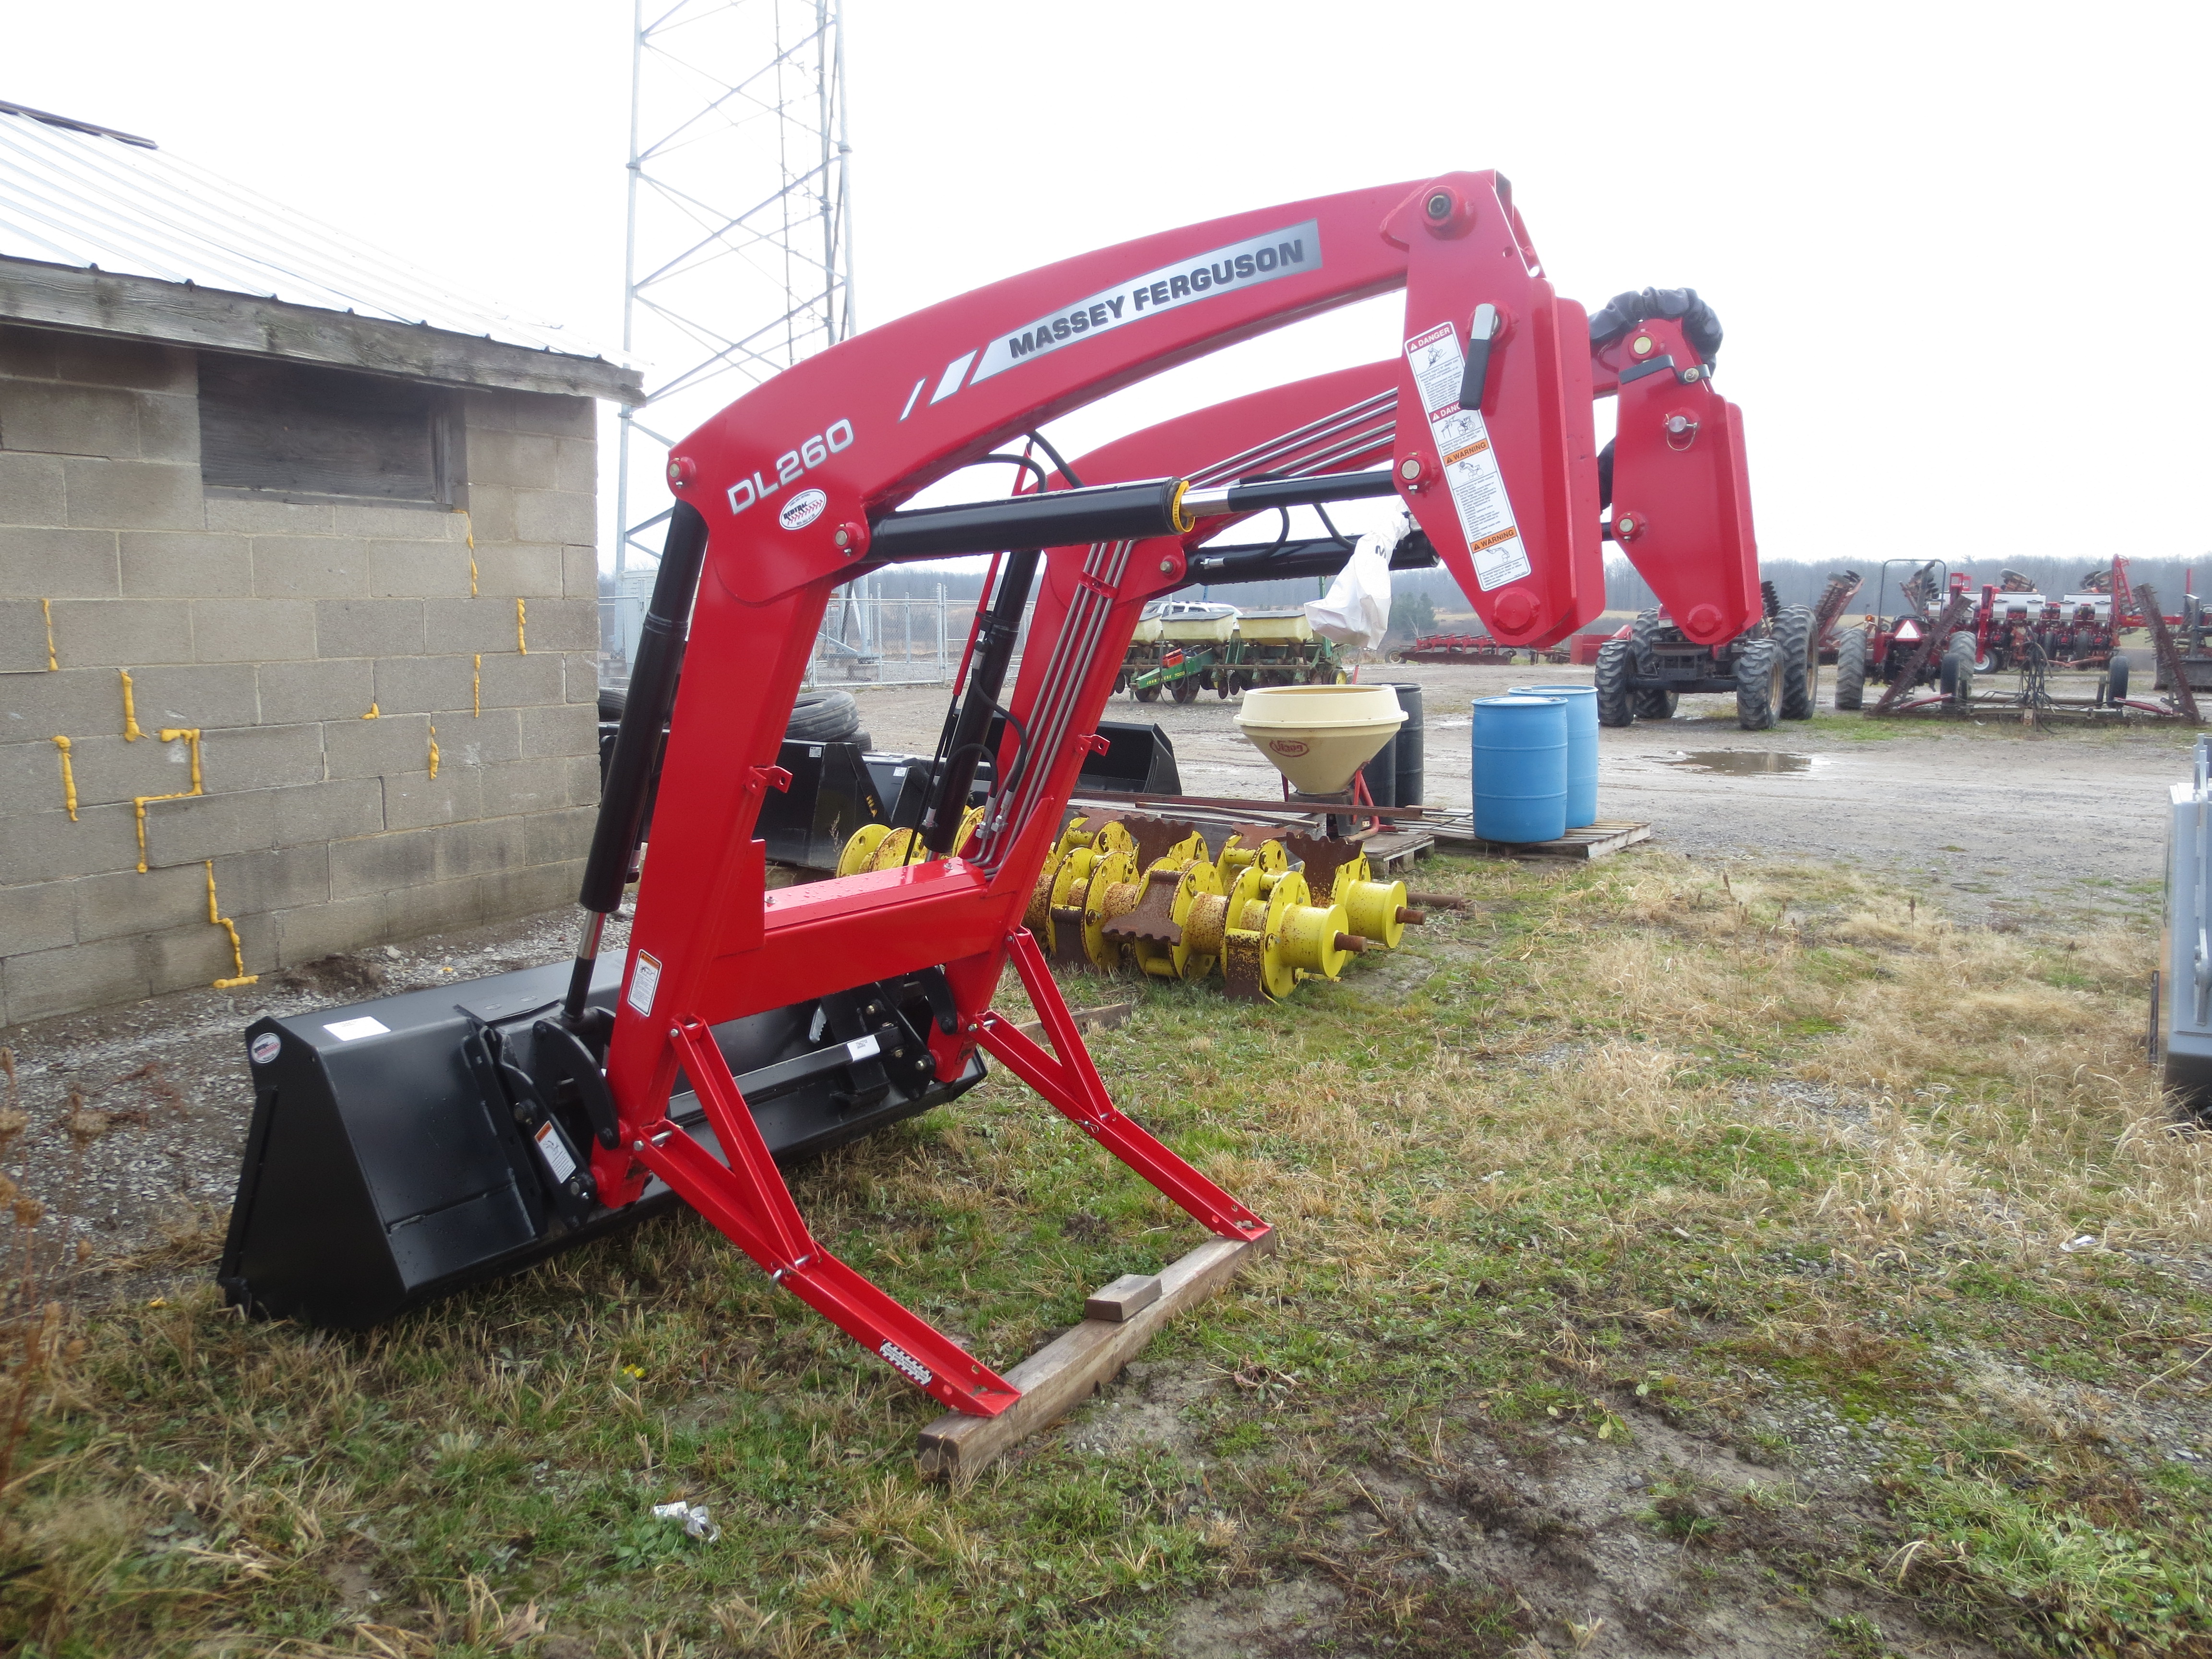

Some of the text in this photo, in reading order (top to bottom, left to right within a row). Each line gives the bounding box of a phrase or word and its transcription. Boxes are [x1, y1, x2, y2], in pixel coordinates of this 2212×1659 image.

[1009, 239, 1304, 359] MASSEY FERGUSON
[1418, 327, 1450, 347] DANGER
[1454, 442, 1486, 459] WARNING
[727, 418, 854, 515] DL260
[783, 501, 807, 521] REDTRAC
[1481, 530, 1514, 547] WARNING
[866, 794, 878, 817] HLA
